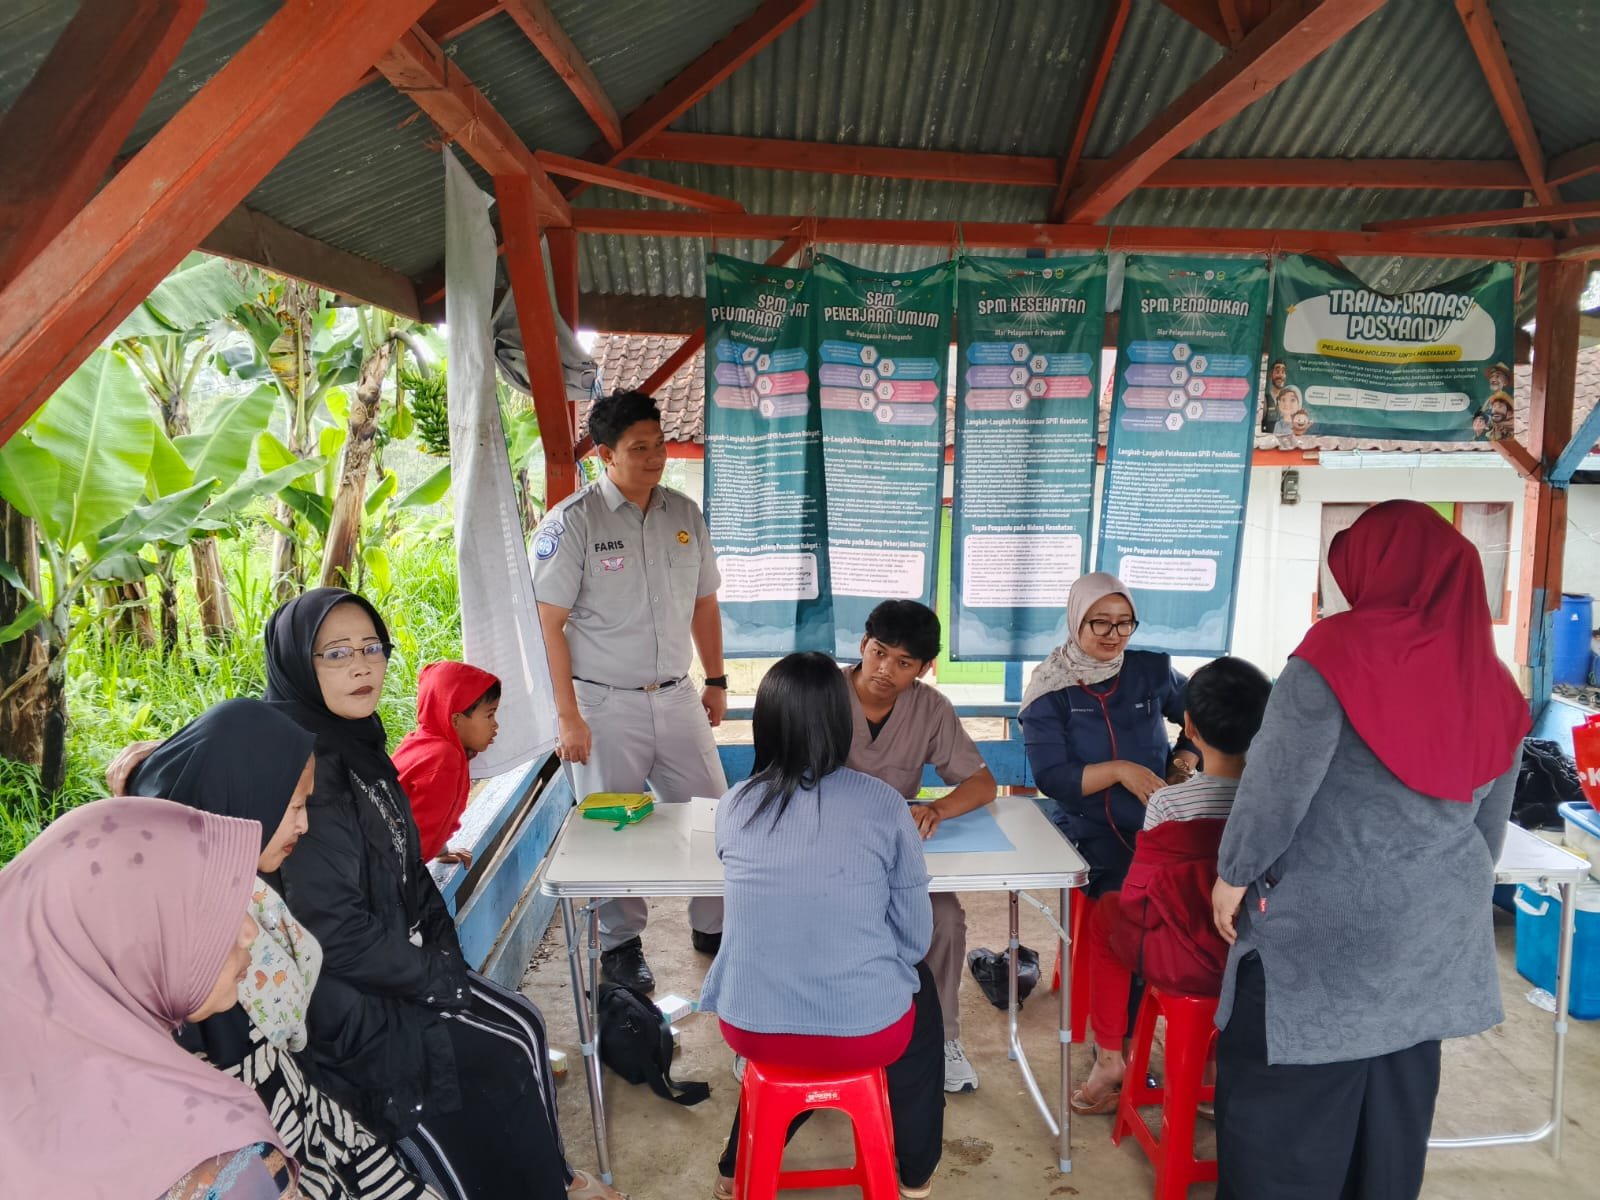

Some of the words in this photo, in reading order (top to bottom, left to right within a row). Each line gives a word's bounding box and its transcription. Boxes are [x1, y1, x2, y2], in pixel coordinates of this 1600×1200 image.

[757, 294, 787, 312] SPM
[866, 291, 895, 306] SPM
[978, 298, 1007, 315] SPM
[1011, 297, 1086, 314] KESEHATAN
[1141, 298, 1169, 314] SPM
[1173, 298, 1249, 317] PENDIDIKAN
[824, 306, 893, 323] PEKERJAAN
[897, 310, 940, 328] UMUM
[594, 540, 625, 553] FARIS
